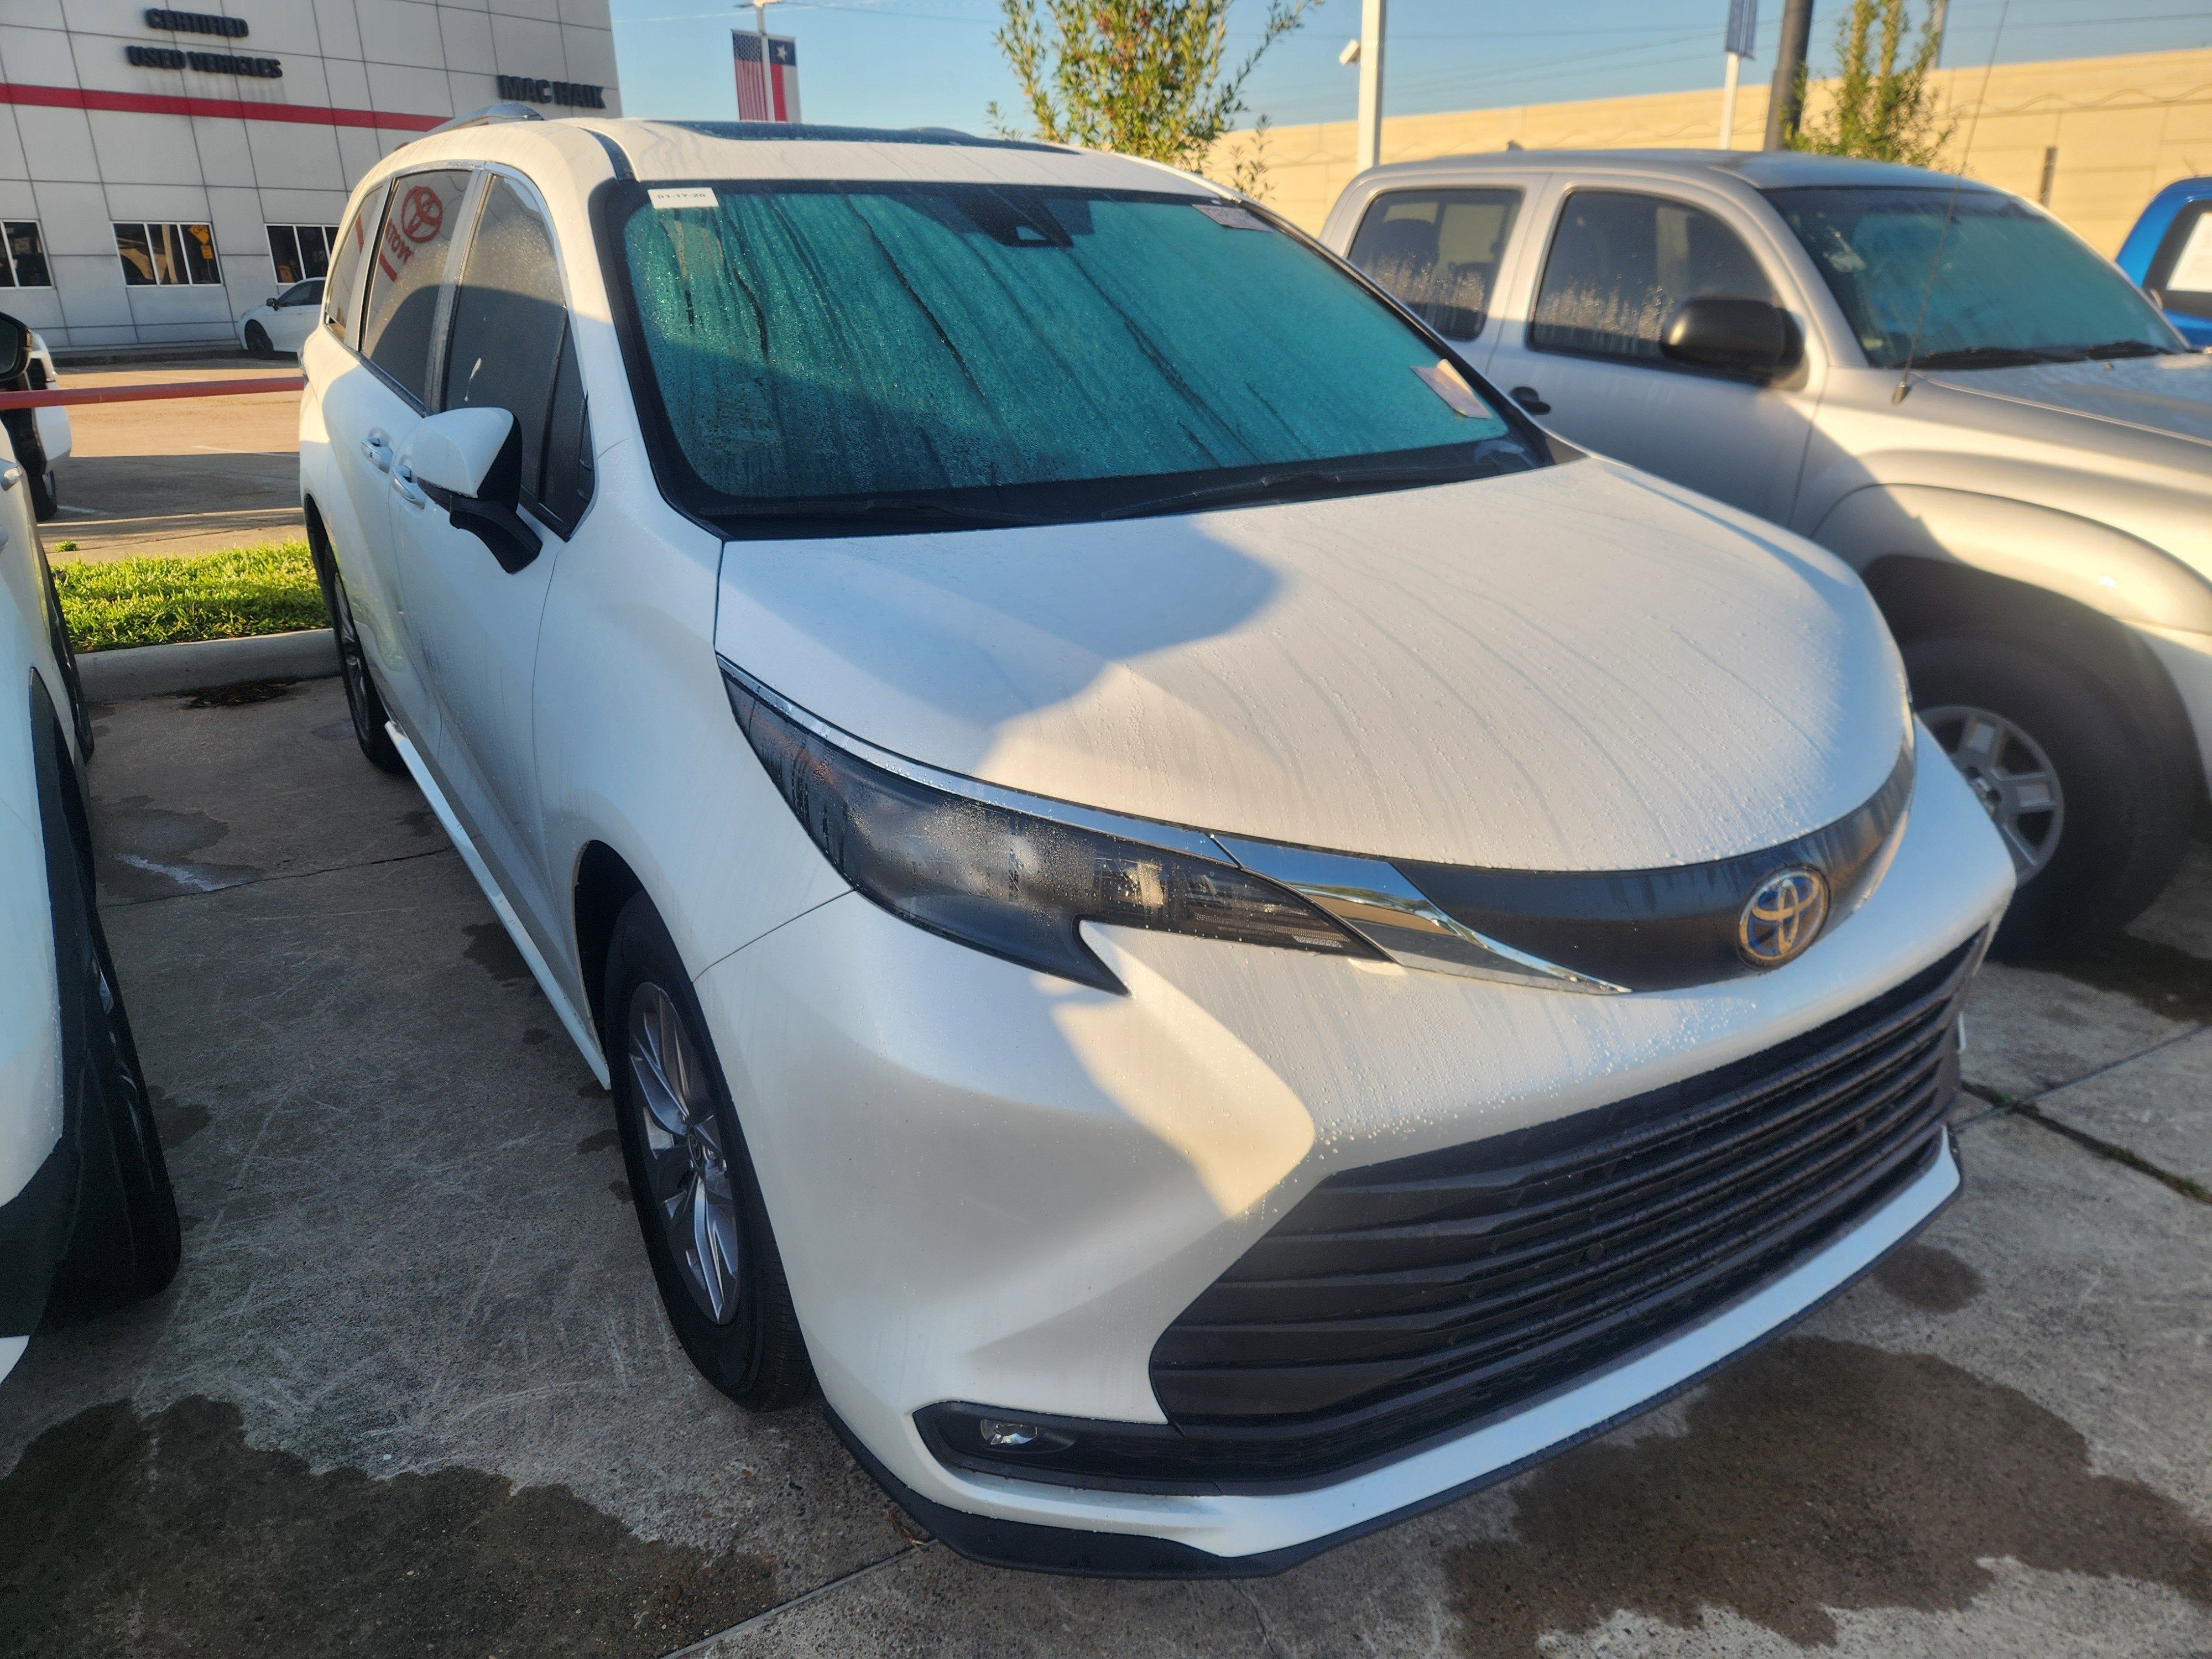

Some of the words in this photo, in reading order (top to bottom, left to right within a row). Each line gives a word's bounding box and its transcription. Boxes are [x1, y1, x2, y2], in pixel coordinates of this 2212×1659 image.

[145, 8, 248, 38] CERTIFIED
[126, 45, 186, 69] USED
[187, 51, 283, 78] VEHICLES
